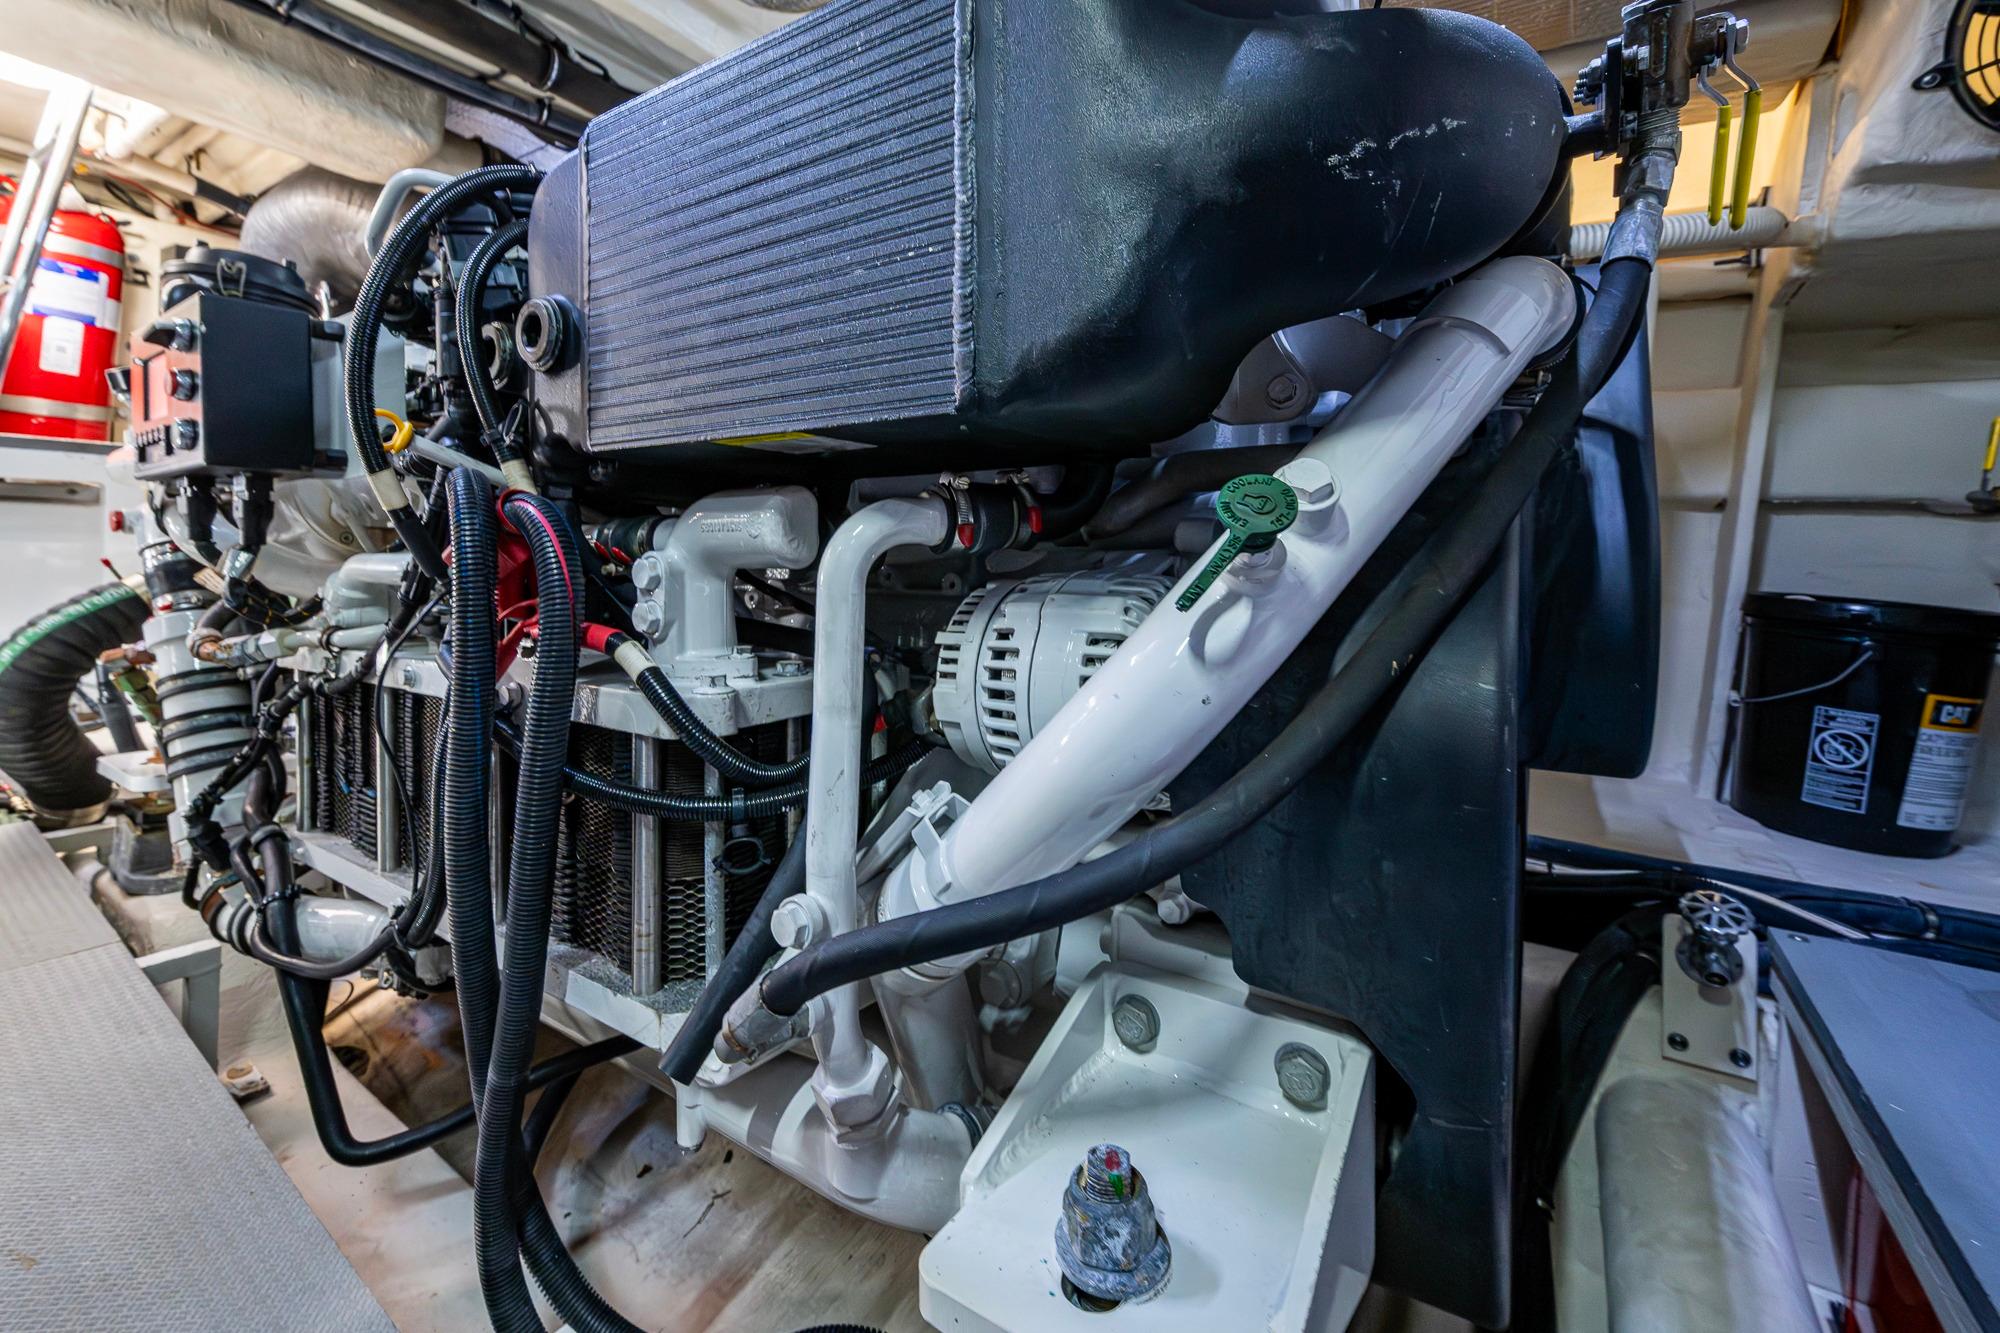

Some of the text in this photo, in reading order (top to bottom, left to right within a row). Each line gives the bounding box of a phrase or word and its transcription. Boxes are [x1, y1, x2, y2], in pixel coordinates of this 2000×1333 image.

[1227, 478, 1274, 494] COOLANT
[1208, 534, 1242, 579] ANALYSIS
[1940, 704, 1971, 724] CAT
